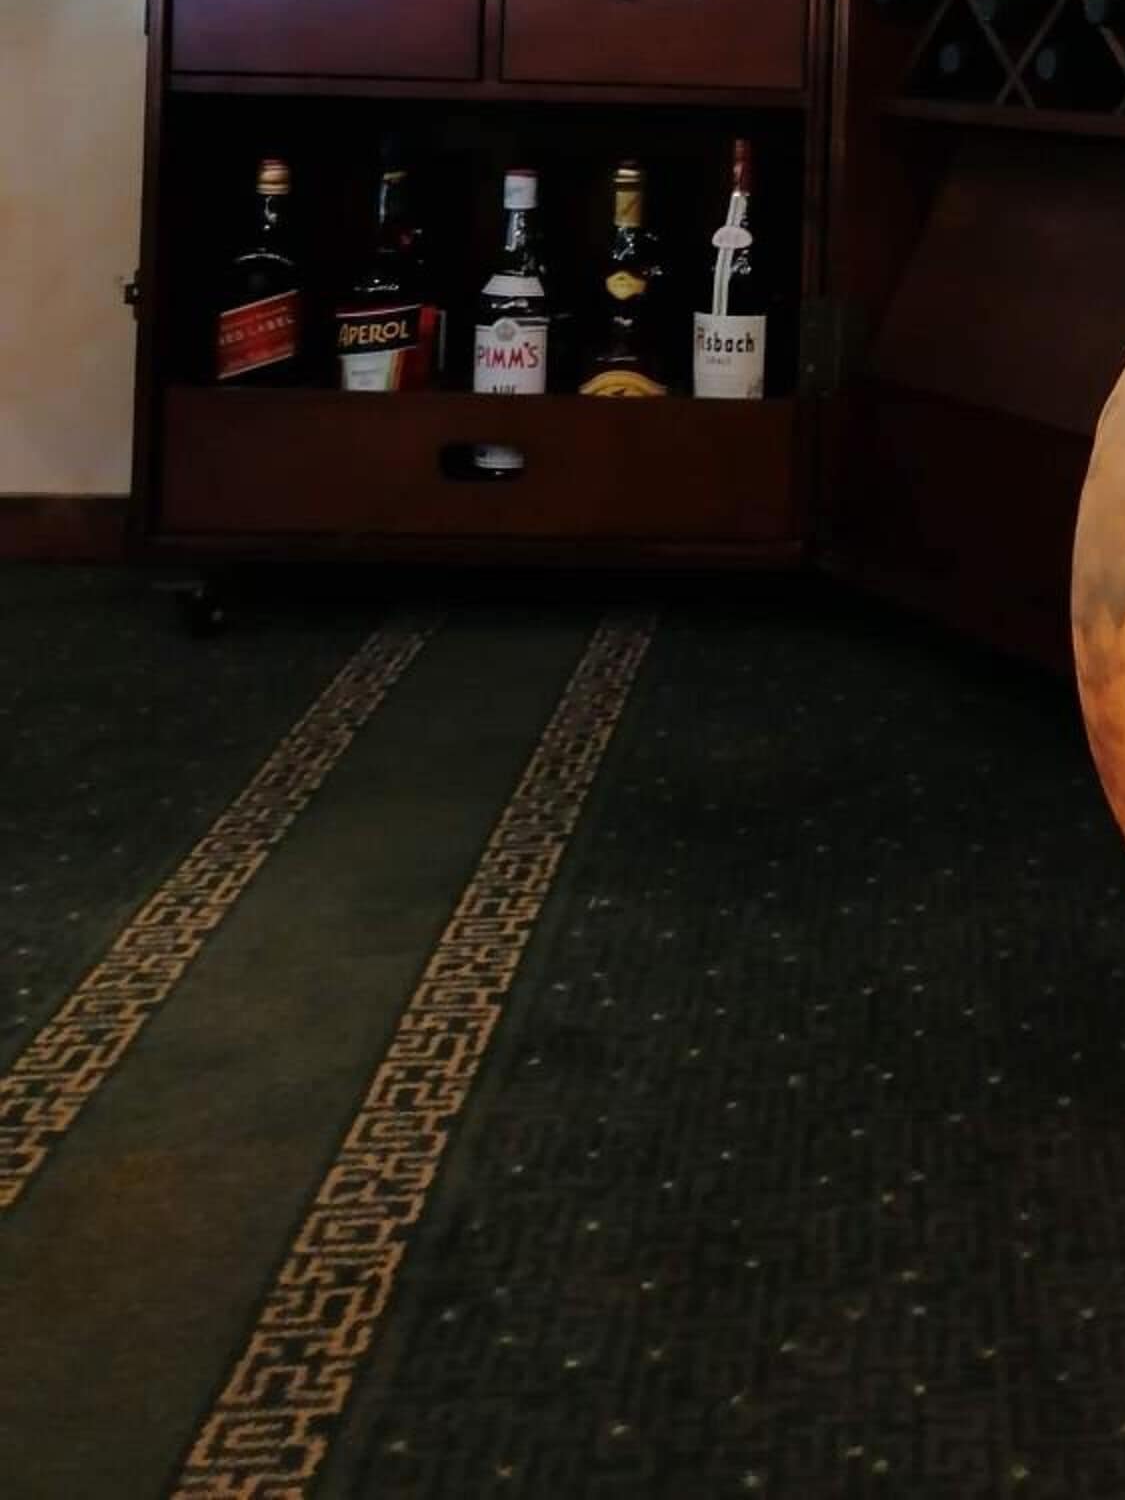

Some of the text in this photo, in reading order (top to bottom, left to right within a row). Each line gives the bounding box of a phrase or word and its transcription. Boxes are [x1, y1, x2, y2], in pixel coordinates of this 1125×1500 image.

[338, 320, 409, 348] APEROL
[697, 326, 755, 353] Asbach
[476, 342, 539, 369] PIMM'S
